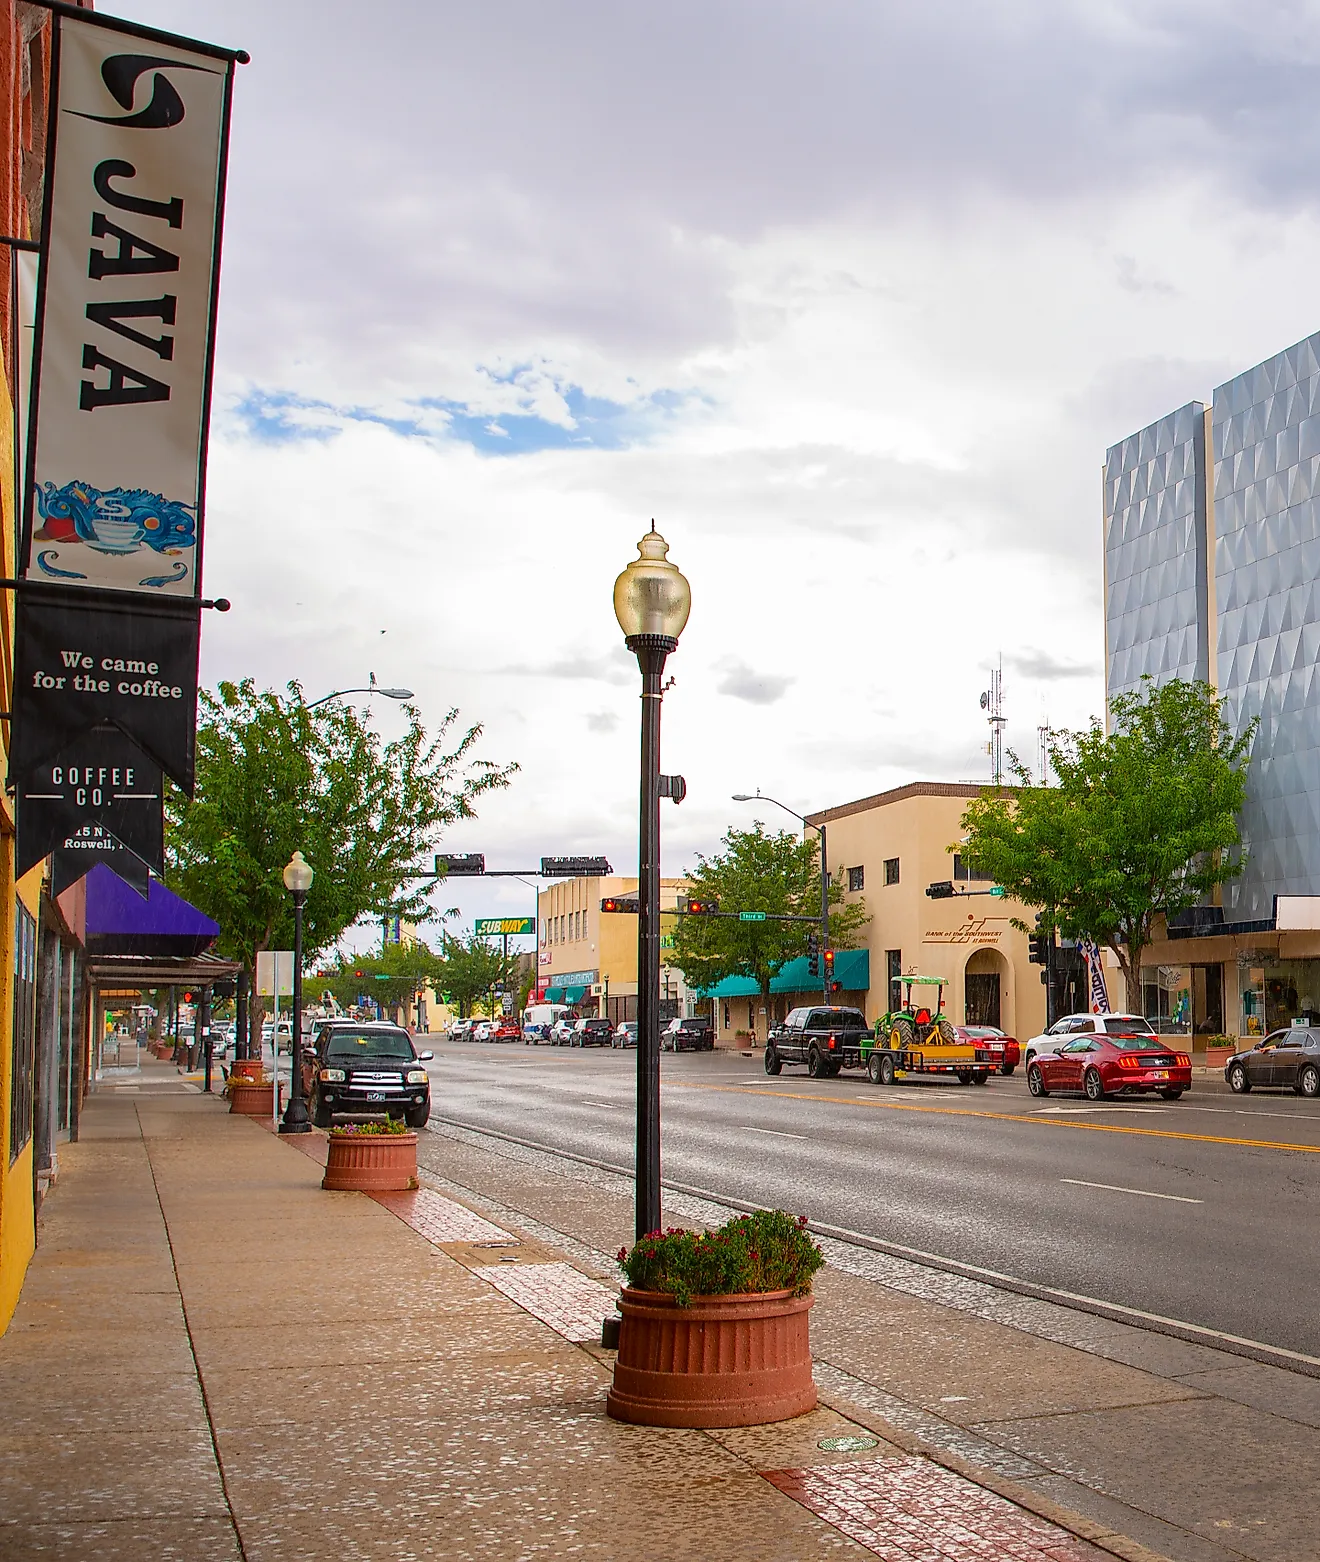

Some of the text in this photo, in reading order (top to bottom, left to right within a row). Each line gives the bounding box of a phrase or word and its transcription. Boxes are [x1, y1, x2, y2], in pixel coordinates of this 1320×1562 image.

[78, 158, 184, 412] JAVA
[61, 650, 160, 676] We came
[32, 671, 183, 700] for the coffee
[52, 766, 136, 787] COFFEE
[76, 788, 113, 806] CO.
[63, 838, 116, 851] Roswell,
[477, 919, 529, 934] SUBWAY
